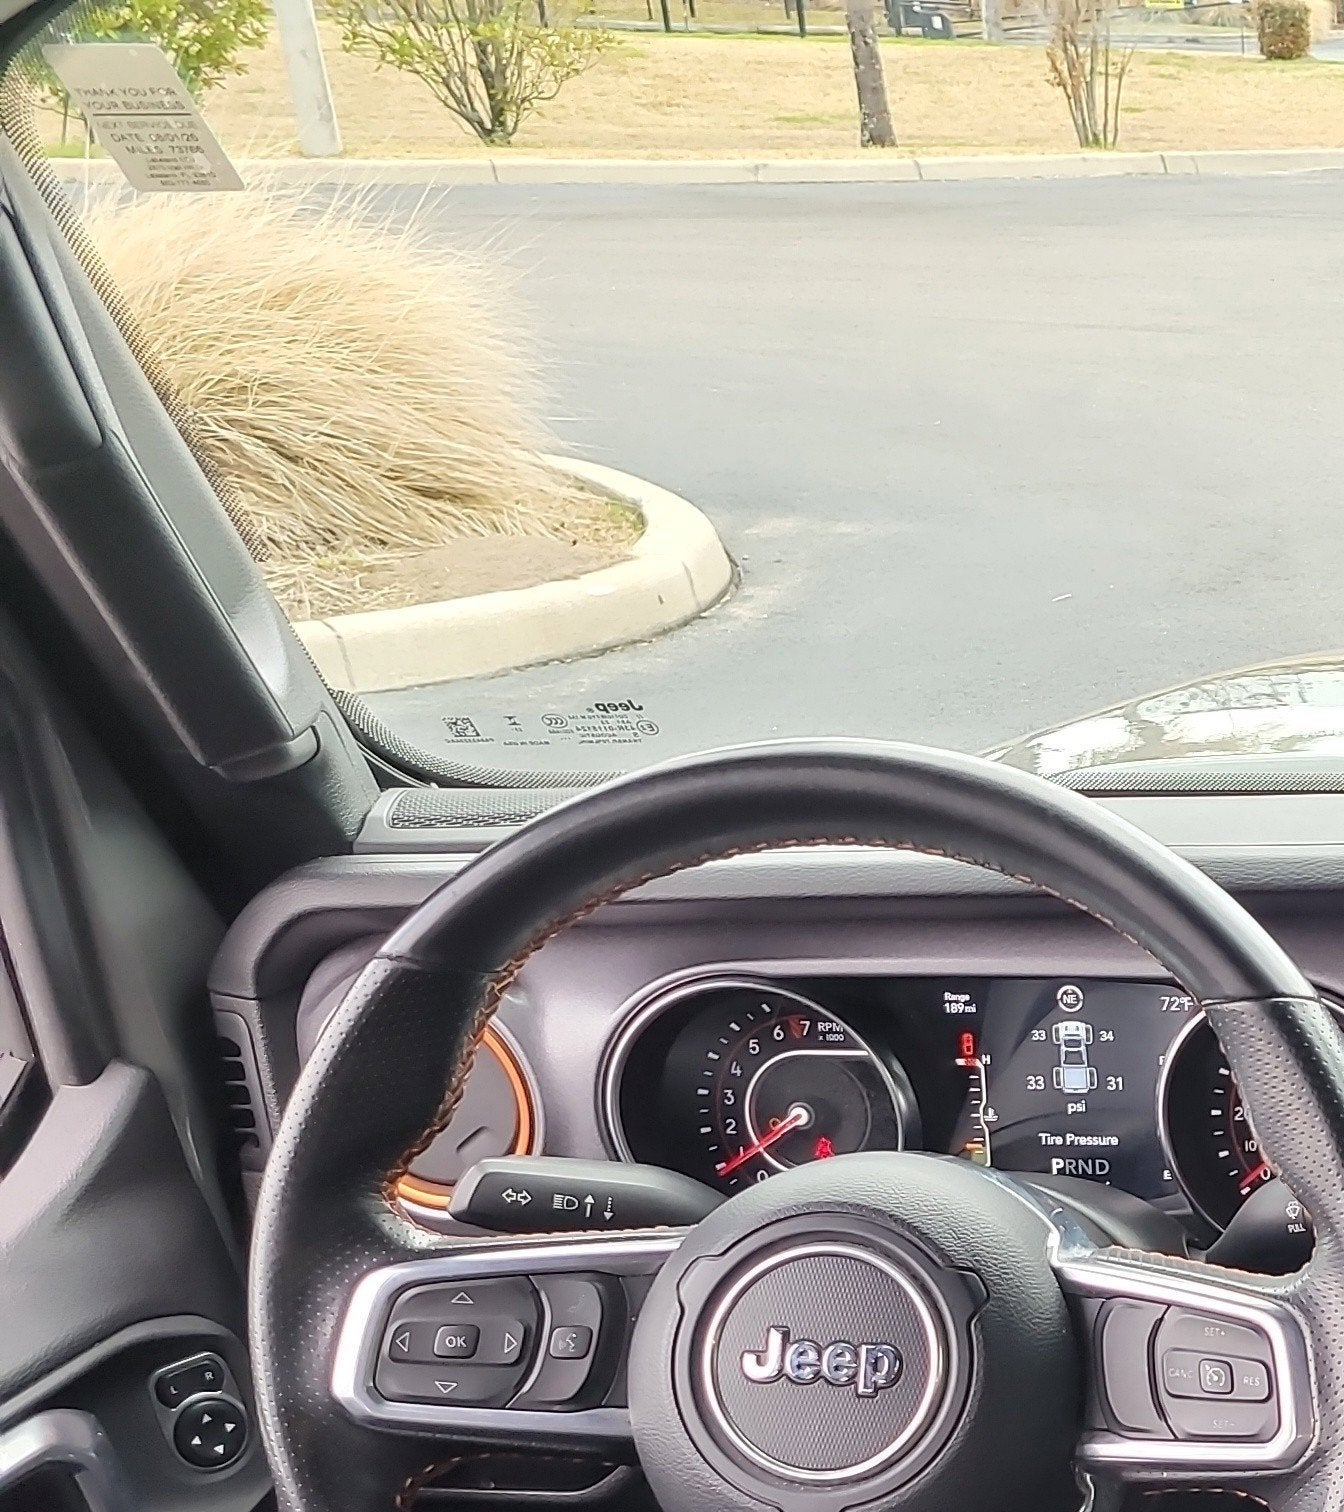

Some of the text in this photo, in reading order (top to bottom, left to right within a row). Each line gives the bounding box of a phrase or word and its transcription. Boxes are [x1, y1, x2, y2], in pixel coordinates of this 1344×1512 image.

[74, 86, 118, 98] THANK
[119, 86, 147, 97] YOU
[85, 100, 186, 111] YOUR BUSINESS
[110, 133, 142, 143] DATE
[125, 146, 163, 155] MILES
[944, 992, 970, 1002] Range
[1062, 994, 1077, 1004] NE
[800, 1021, 812, 1035] 7
[817, 1022, 845, 1032] RPM
[773, 1027, 784, 1040] 6
[1031, 1030, 1046, 1040] 33
[1099, 1031, 1114, 1041] 34
[749, 1039, 760, 1054] 5
[981, 1055, 990, 1064] H
[731, 1062, 742, 1077] 4
[1026, 1076, 1045, 1090] 33
[1107, 1077, 1123, 1090] 31
[723, 1090, 735, 1104] 3
[1067, 1101, 1086, 1114] psi
[726, 1119, 738, 1134] 2
[1039, 1133, 1119, 1146] Tire Pressure
[1245, 1140, 1257, 1151] 10
[1052, 1159, 1110, 1175] PRND
[1163, 1170, 1172, 1180] E
[1261, 1169, 1271, 1180] 0
[1288, 1223, 1306, 1233] PULL
[445, 1335, 467, 1348] OK
[742, 1326, 902, 1398] Jeep
[205, 1371, 214, 1381] R
[1243, 1375, 1260, 1387] RES
[170, 1387, 178, 1395] L
